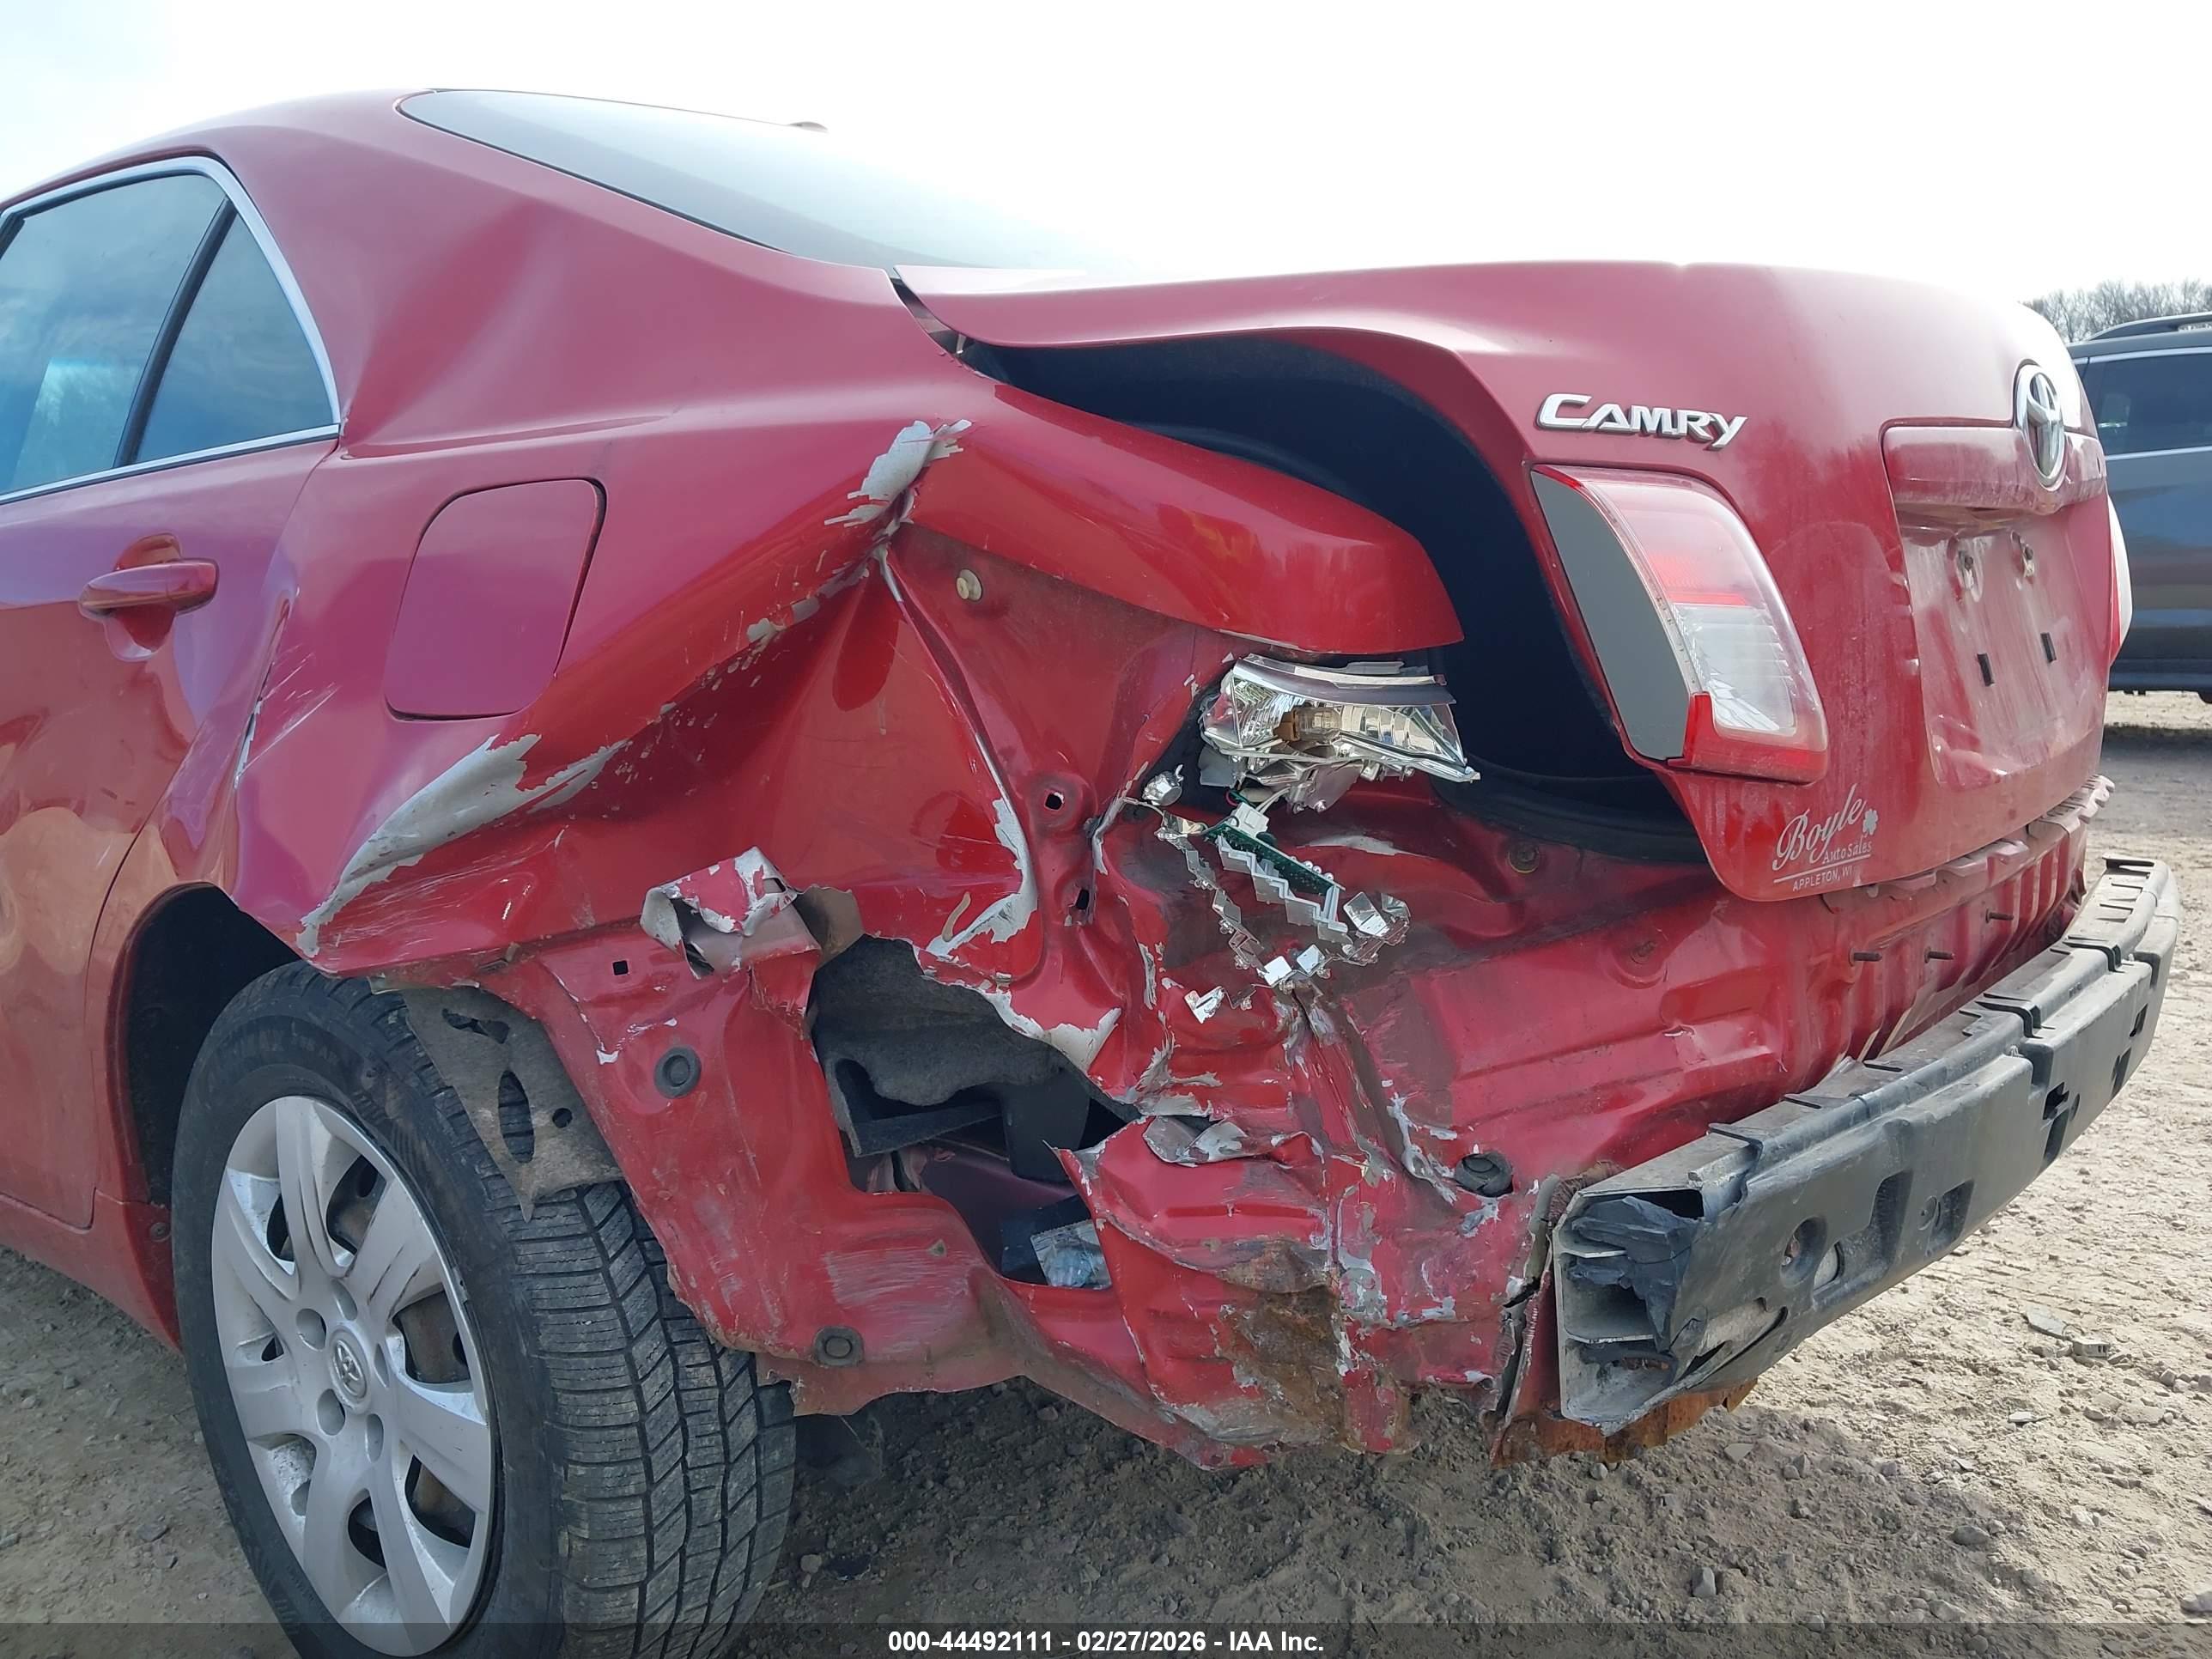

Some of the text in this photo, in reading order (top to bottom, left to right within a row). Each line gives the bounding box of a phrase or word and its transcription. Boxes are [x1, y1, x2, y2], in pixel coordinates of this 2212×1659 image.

[1537, 392, 1748, 451] CAMRY
[1772, 783, 1867, 871] Boyle
[1822, 836, 1872, 864] Auto Sales
[1792, 865, 1853, 891] APPLETON, WI
